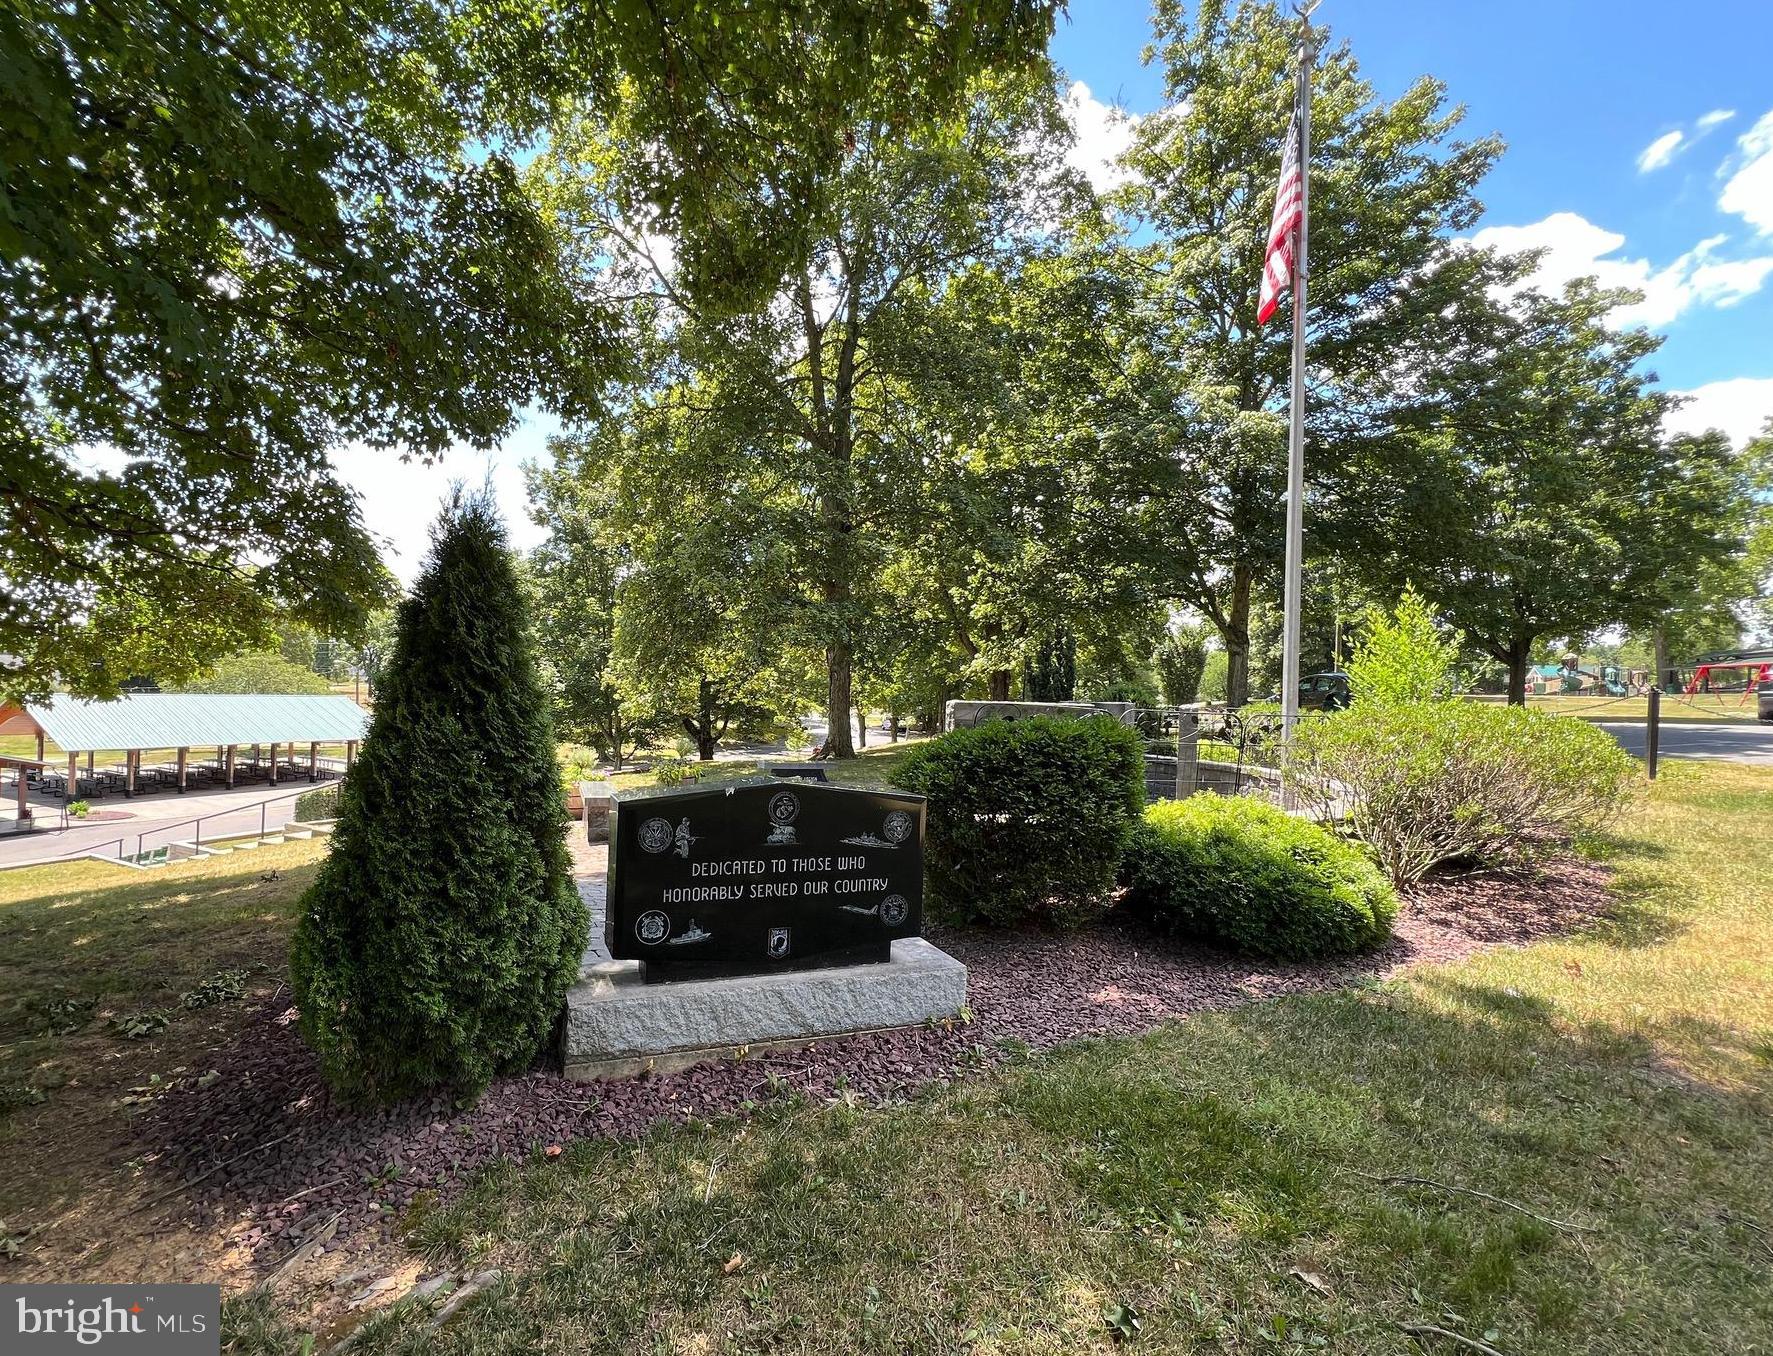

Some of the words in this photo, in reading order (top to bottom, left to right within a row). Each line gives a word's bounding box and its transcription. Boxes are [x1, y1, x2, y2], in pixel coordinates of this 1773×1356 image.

[692, 860, 765, 876] DEDICATED
[770, 858, 786, 872] TO
[791, 857, 831, 871] THOSE
[838, 855, 865, 870] WHO
[663, 885, 743, 902] HONORABLY
[749, 882, 797, 898] SERVED
[804, 881, 828, 894] OUR
[835, 877, 888, 893] COUNTRY
